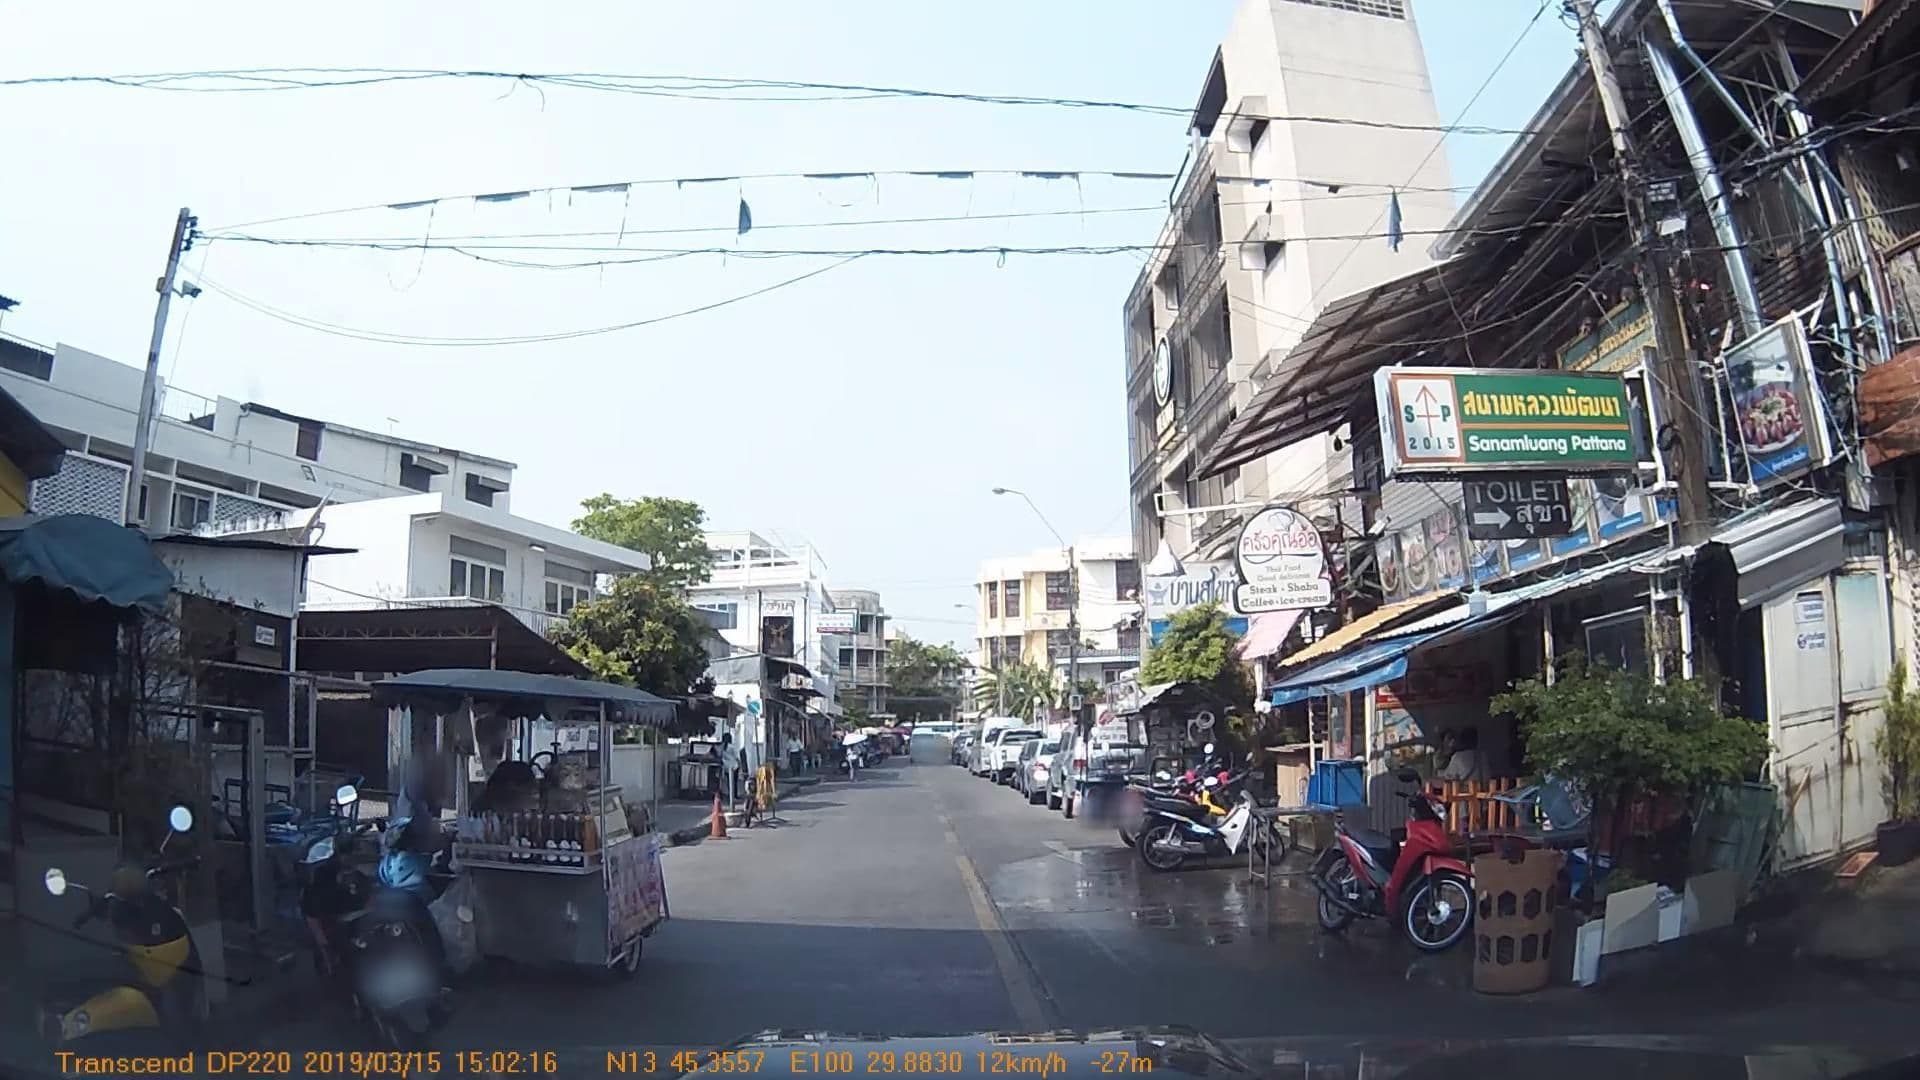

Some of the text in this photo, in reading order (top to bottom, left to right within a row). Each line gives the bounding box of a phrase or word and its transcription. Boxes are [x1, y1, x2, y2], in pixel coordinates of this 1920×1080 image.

[1463, 387, 1621, 417] สนามหลวงพัฒนา
[1404, 404, 1451, 423] S P
[1408, 436, 1456, 450] 2015
[1468, 434, 1627, 455] Sanamluang Pattana
[1467, 480, 1563, 504] TOILET
[1516, 504, 1568, 534] สุขา
[1249, 585, 1278, 595] Steak
[1241, 597, 1275, 608] Coffee
